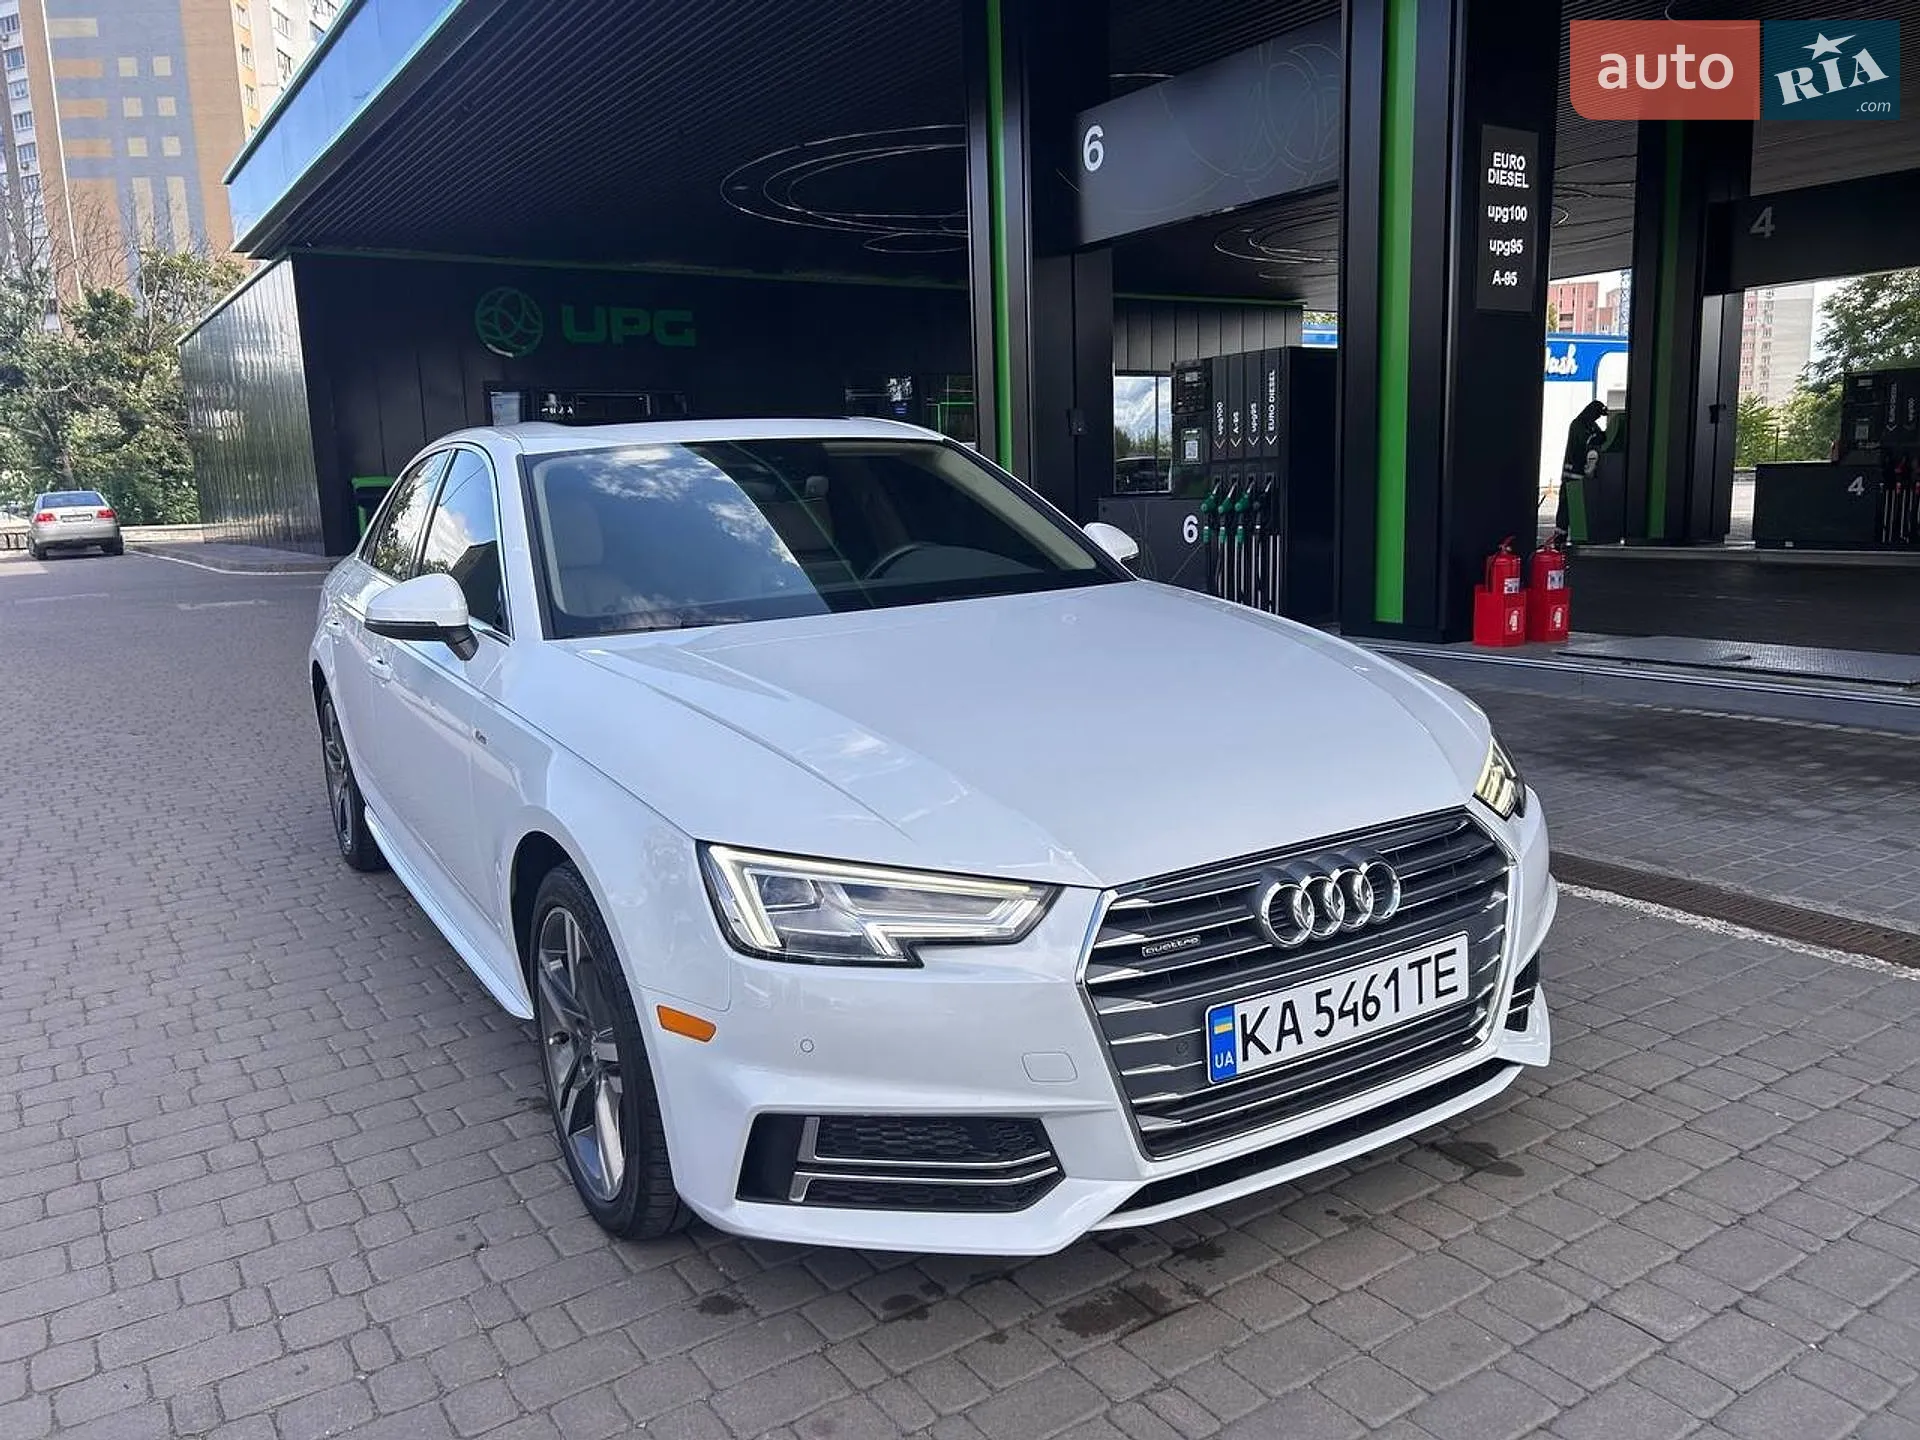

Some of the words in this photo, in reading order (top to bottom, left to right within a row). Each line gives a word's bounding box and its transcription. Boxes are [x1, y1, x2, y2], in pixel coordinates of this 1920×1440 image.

[1083, 124, 1104, 172] 6
[1492, 151, 1526, 171] EURO
[1487, 167, 1530, 189] DIESEL
[1487, 205, 1528, 223] upg100
[1750, 206, 1776, 239] 4
[1489, 238, 1524, 257] upg95
[1492, 269, 1518, 287] A-95
[560, 305, 697, 347] UPG
[1268, 369, 1276, 403] DIESEL
[1267, 404, 1275, 432] EURO
[1848, 476, 1866, 496] 4
[1182, 514, 1198, 543] 6
[1240, 999, 1304, 1062] KA
[1314, 971, 1400, 1037] 5461
[1408, 947, 1459, 1005] TE
[1215, 1049, 1235, 1069] UA
